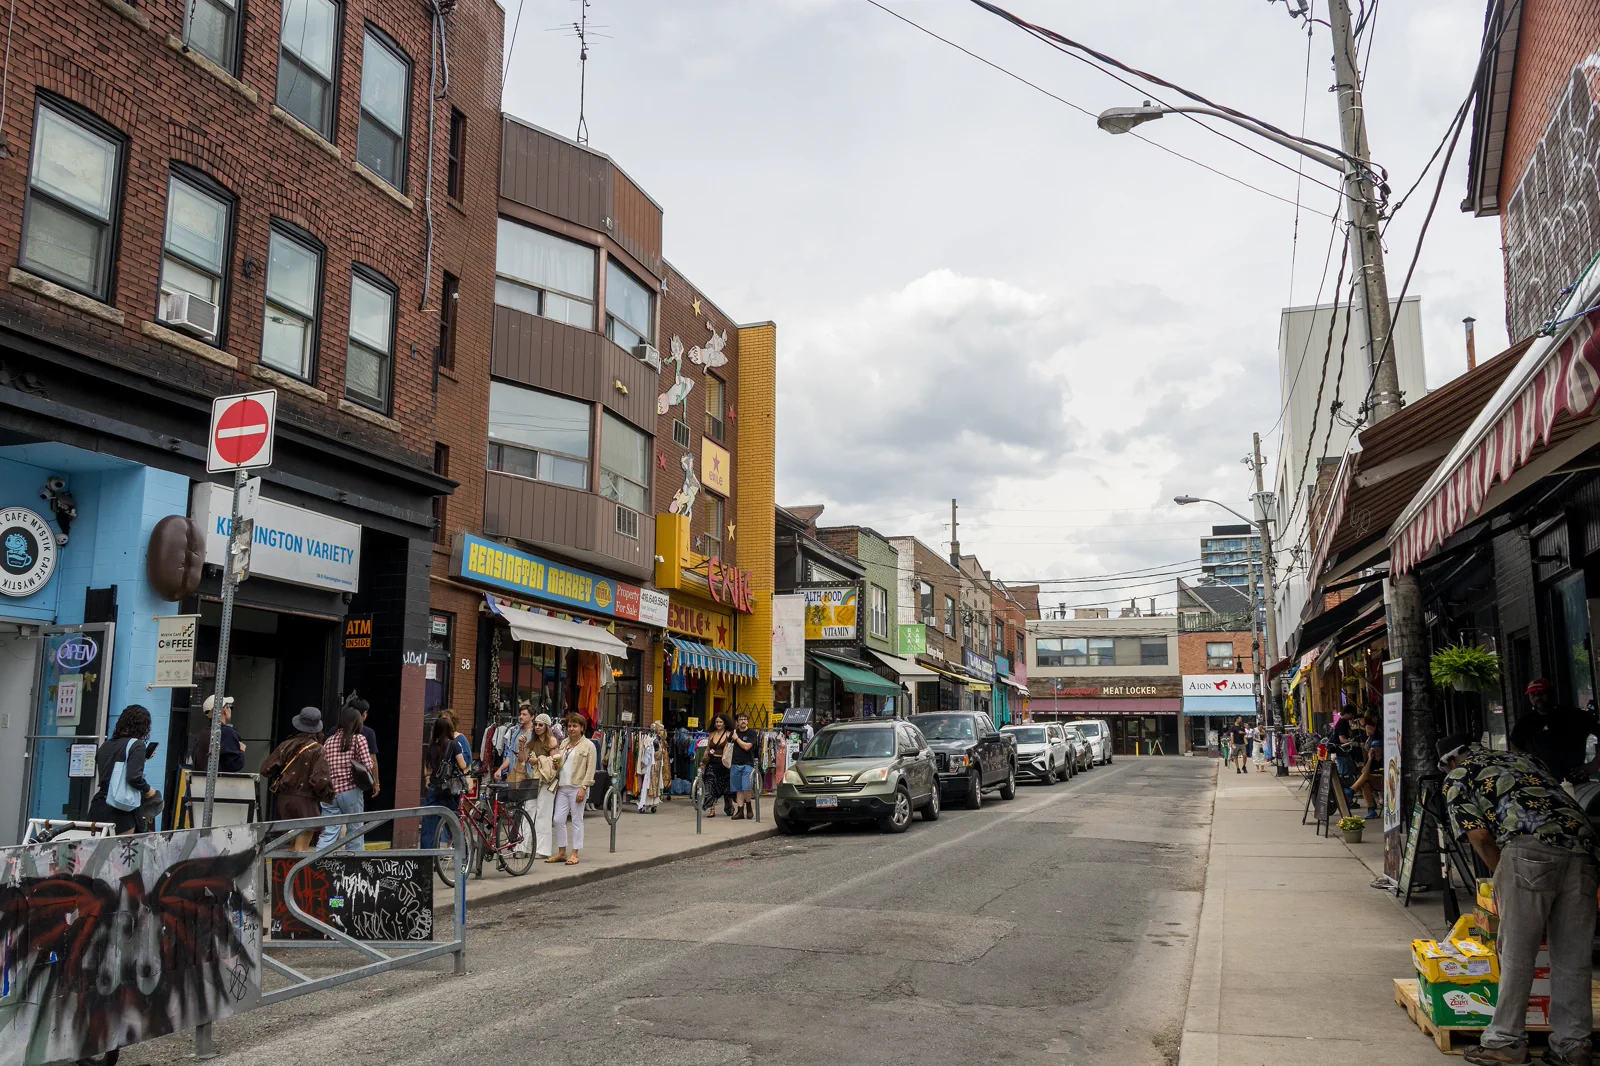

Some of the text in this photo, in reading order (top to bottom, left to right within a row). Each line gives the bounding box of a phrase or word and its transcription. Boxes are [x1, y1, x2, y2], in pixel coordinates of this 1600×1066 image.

[4, 512, 28, 523] CAFE
[30, 518, 51, 552] MYSTIK
[216, 516, 355, 565] KEINGTON VARIETY
[34, 556, 51, 581] CAFE
[468, 542, 593, 603] KENSINGTON MARKET
[2, 577, 36, 590] MYSTIK
[708, 555, 754, 615] EXILE
[617, 585, 640, 603] Property
[824, 591, 842, 602] FOOD
[616, 601, 626, 614] For
[626, 604, 637, 616] Sale
[667, 602, 704, 636] EXILE
[346, 620, 371, 635] ATM
[824, 627, 849, 637] VITAMIN
[158, 638, 193, 648] COFFEE
[346, 638, 370, 647] INSIDE
[58, 643, 96, 662] OPEN
[461, 658, 471, 670] 58
[646, 683, 653, 693] 60
[1103, 686, 1124, 695] MEAT
[1126, 686, 1157, 695] LOCKER
[1189, 681, 1255, 690] AION AMO
